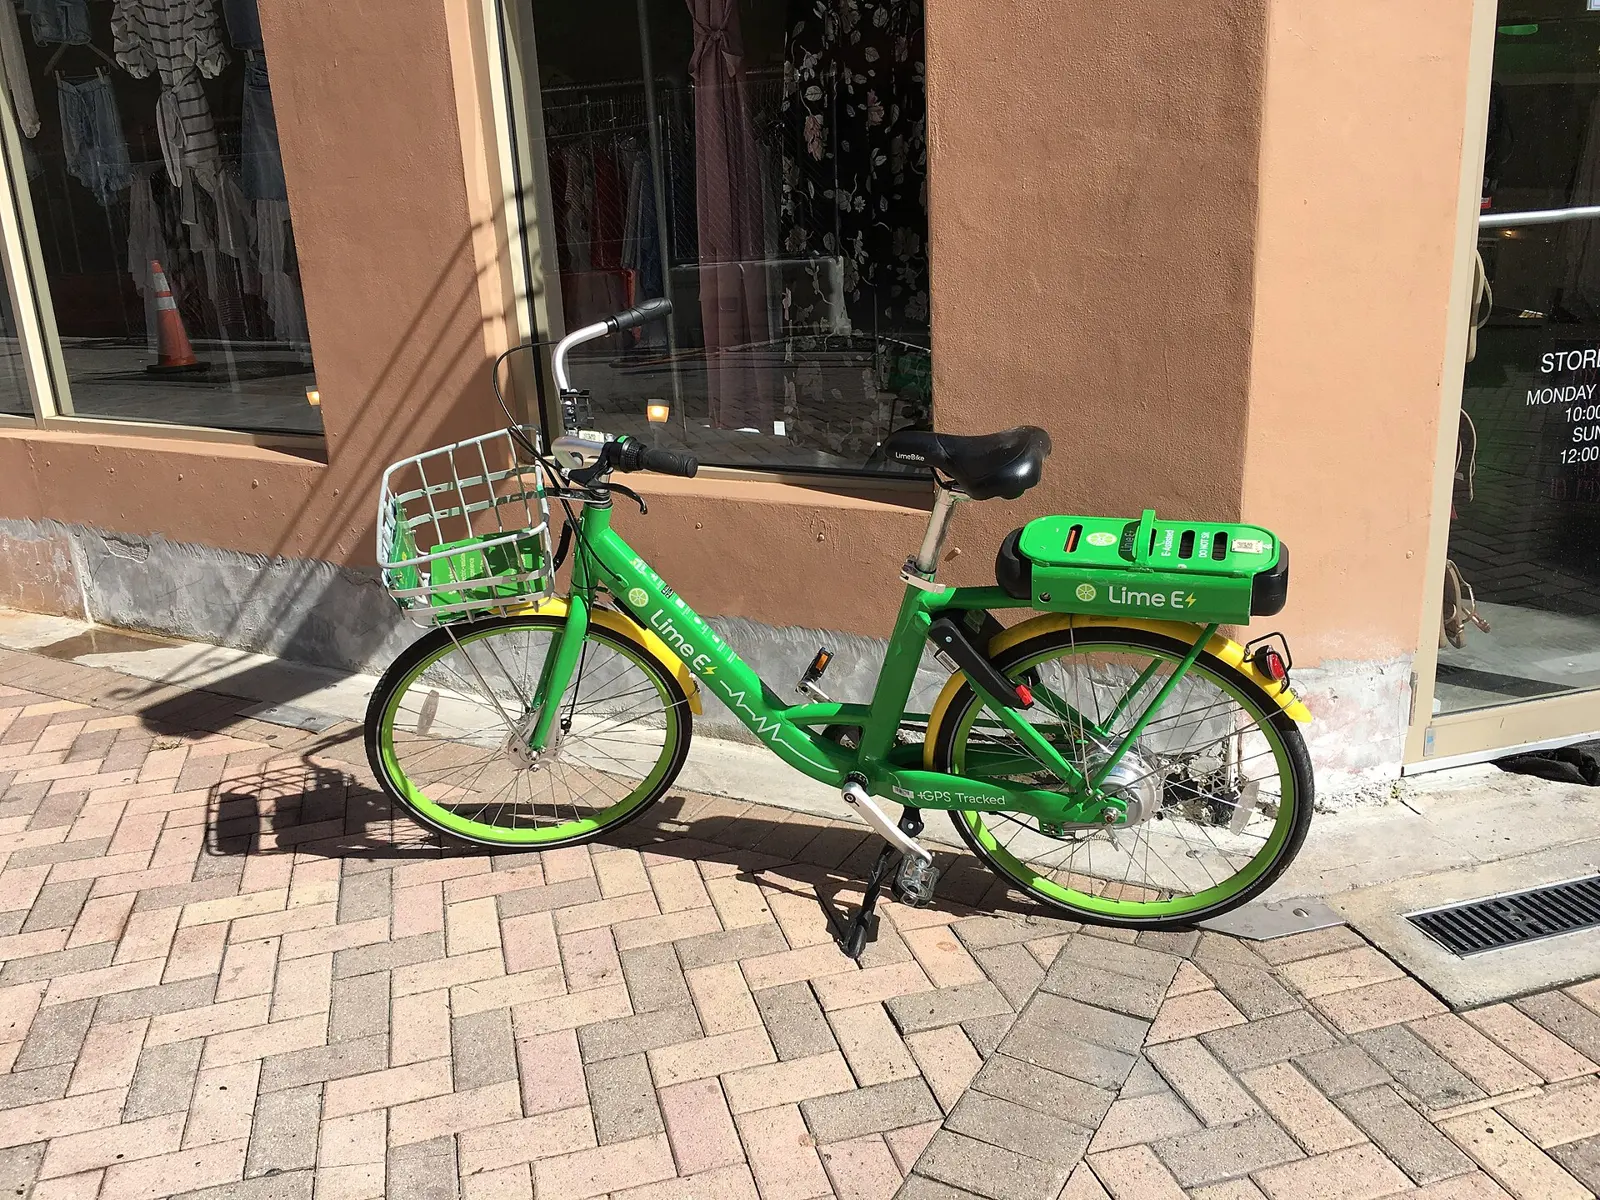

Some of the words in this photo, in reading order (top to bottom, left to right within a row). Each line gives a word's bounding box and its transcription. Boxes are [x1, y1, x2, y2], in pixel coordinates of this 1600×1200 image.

[1541, 349, 1600, 373] STOR
[1526, 384, 1597, 406] MONDAY
[895, 451, 925, 462] LimeBike
[1560, 446, 1599, 464] 12:00
[1108, 585, 1166, 607] Lime
[1171, 591, 1185, 609] E
[650, 609, 694, 657] Lime
[692, 654, 711, 671] E
[955, 792, 1006, 805] Tracked
